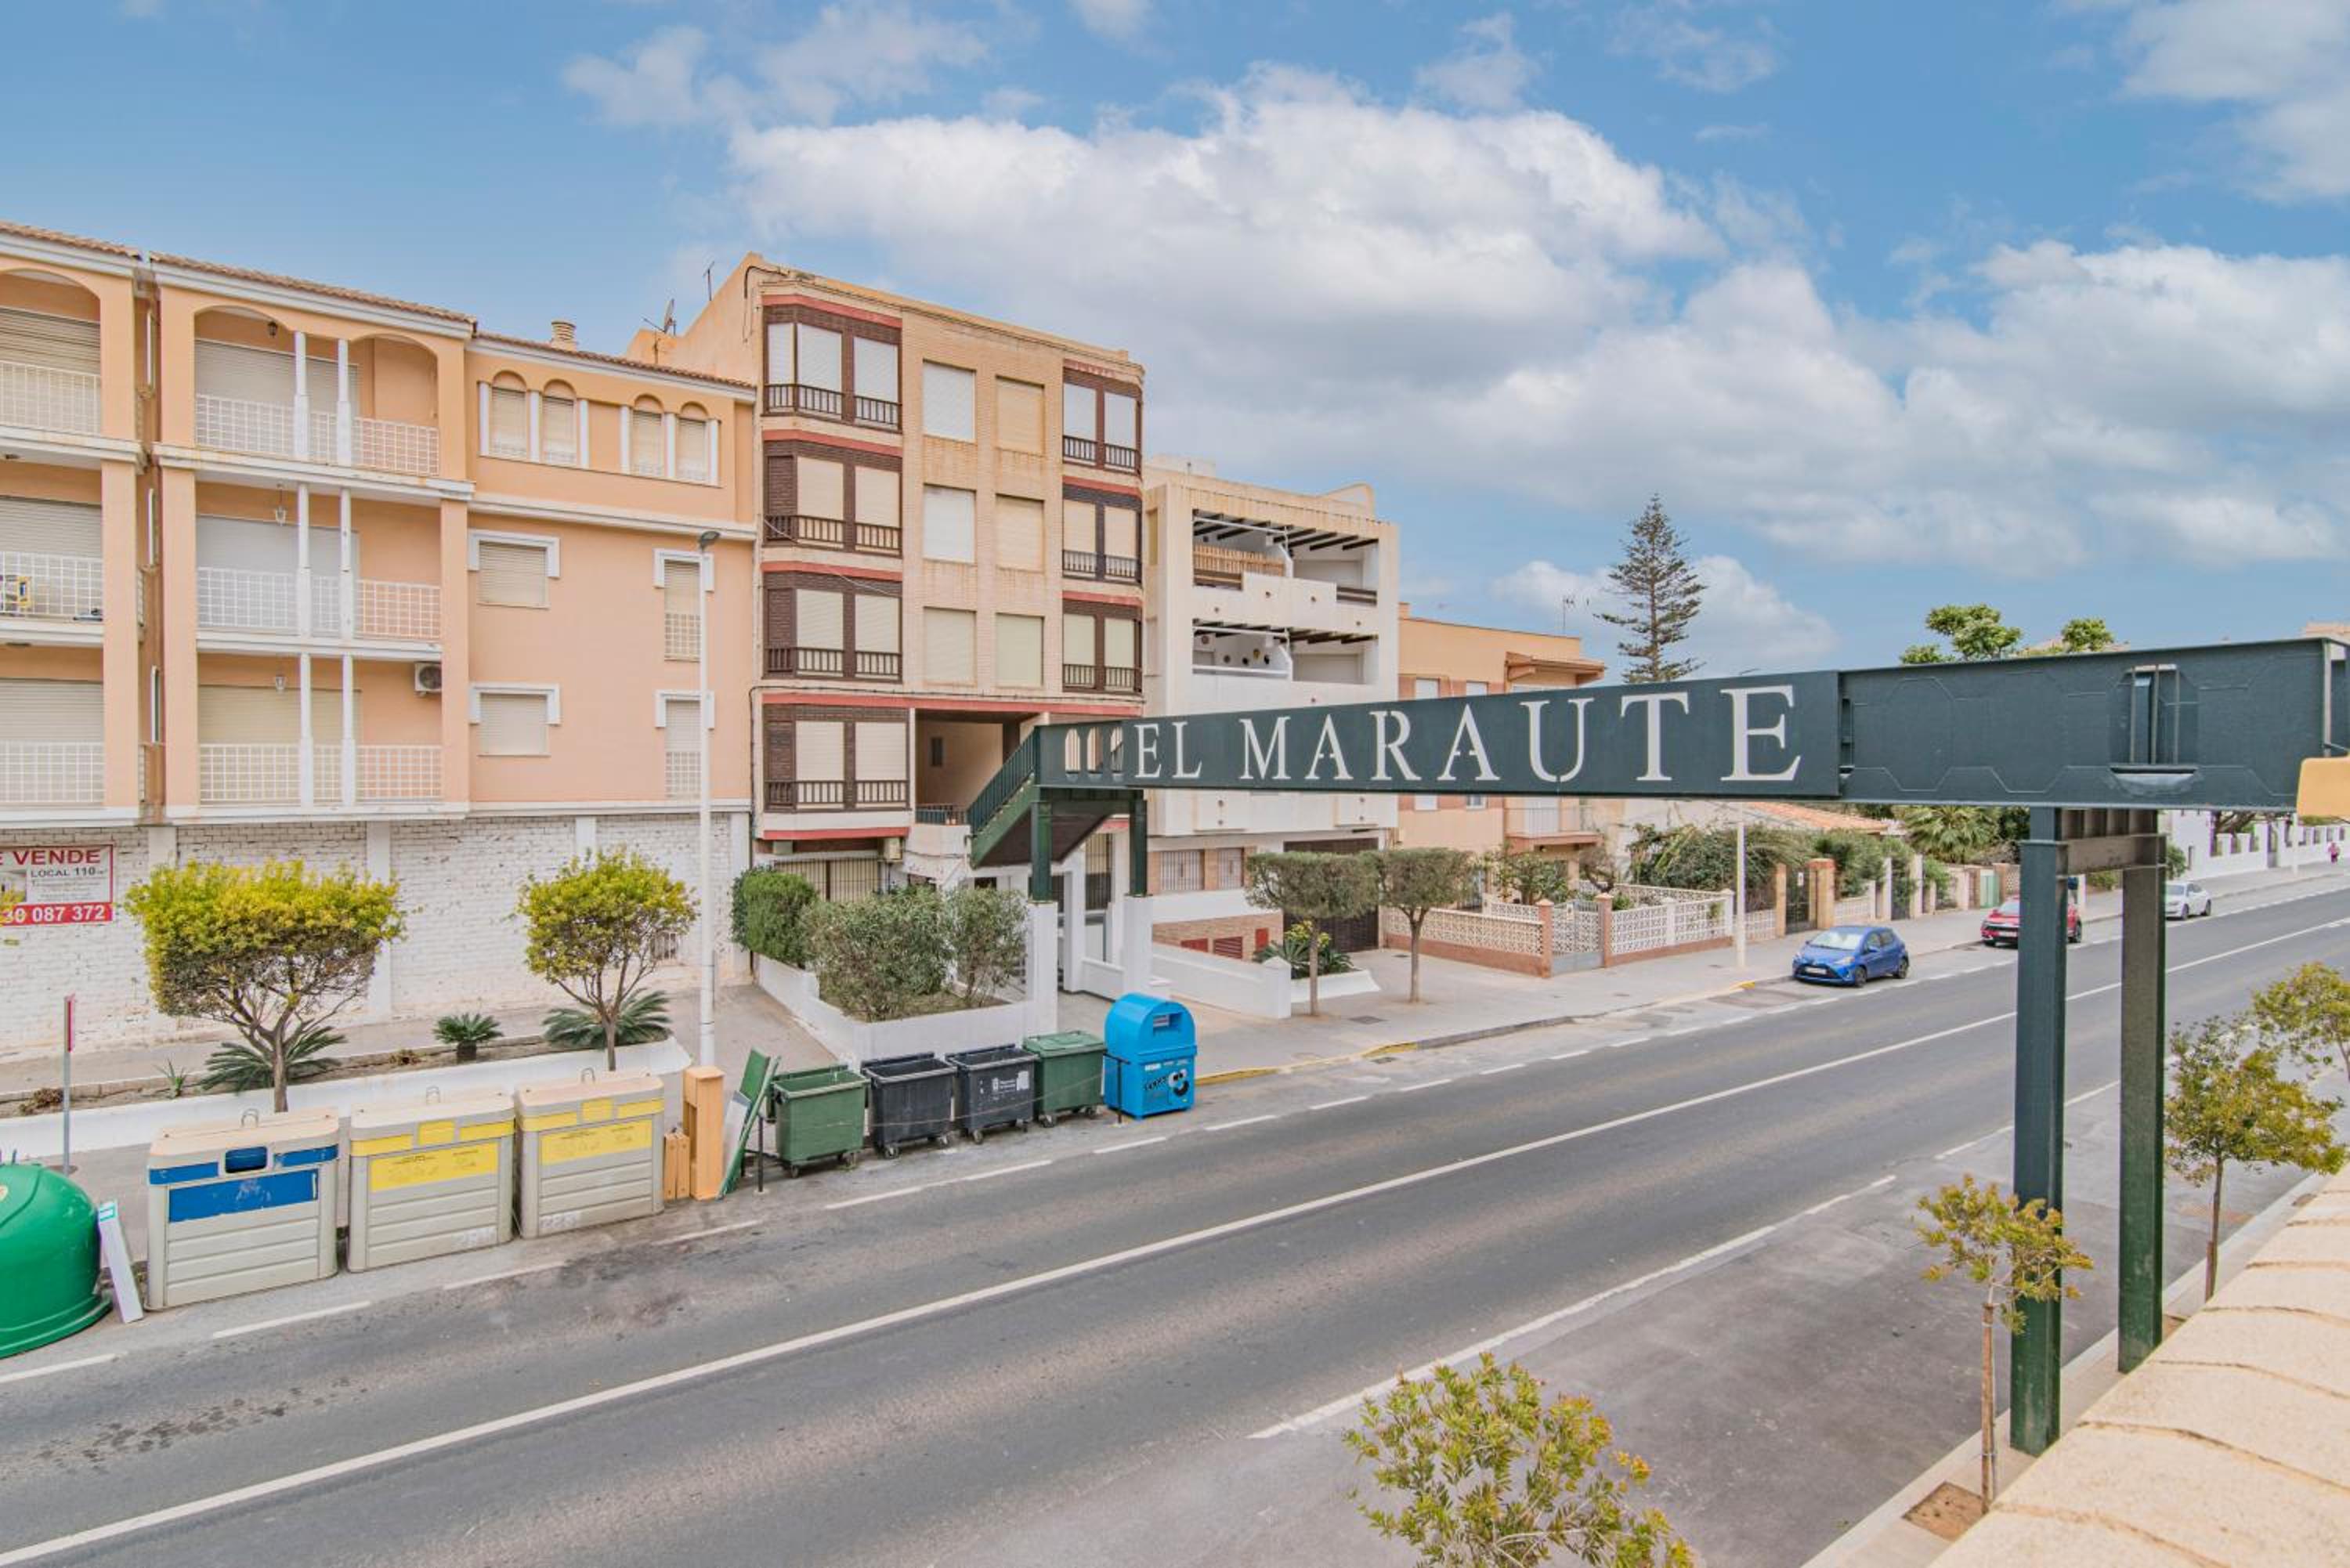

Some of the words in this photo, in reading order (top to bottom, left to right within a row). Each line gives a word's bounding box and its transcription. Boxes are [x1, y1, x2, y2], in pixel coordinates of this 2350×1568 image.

[1133, 721, 1203, 779] EL
[1238, 684, 1802, 782] MARAUTE
[13, 849, 101, 865] VENDE
[75, 866, 96, 876] 110
[32, 906, 66, 922] 087
[72, 905, 105, 920] 372
